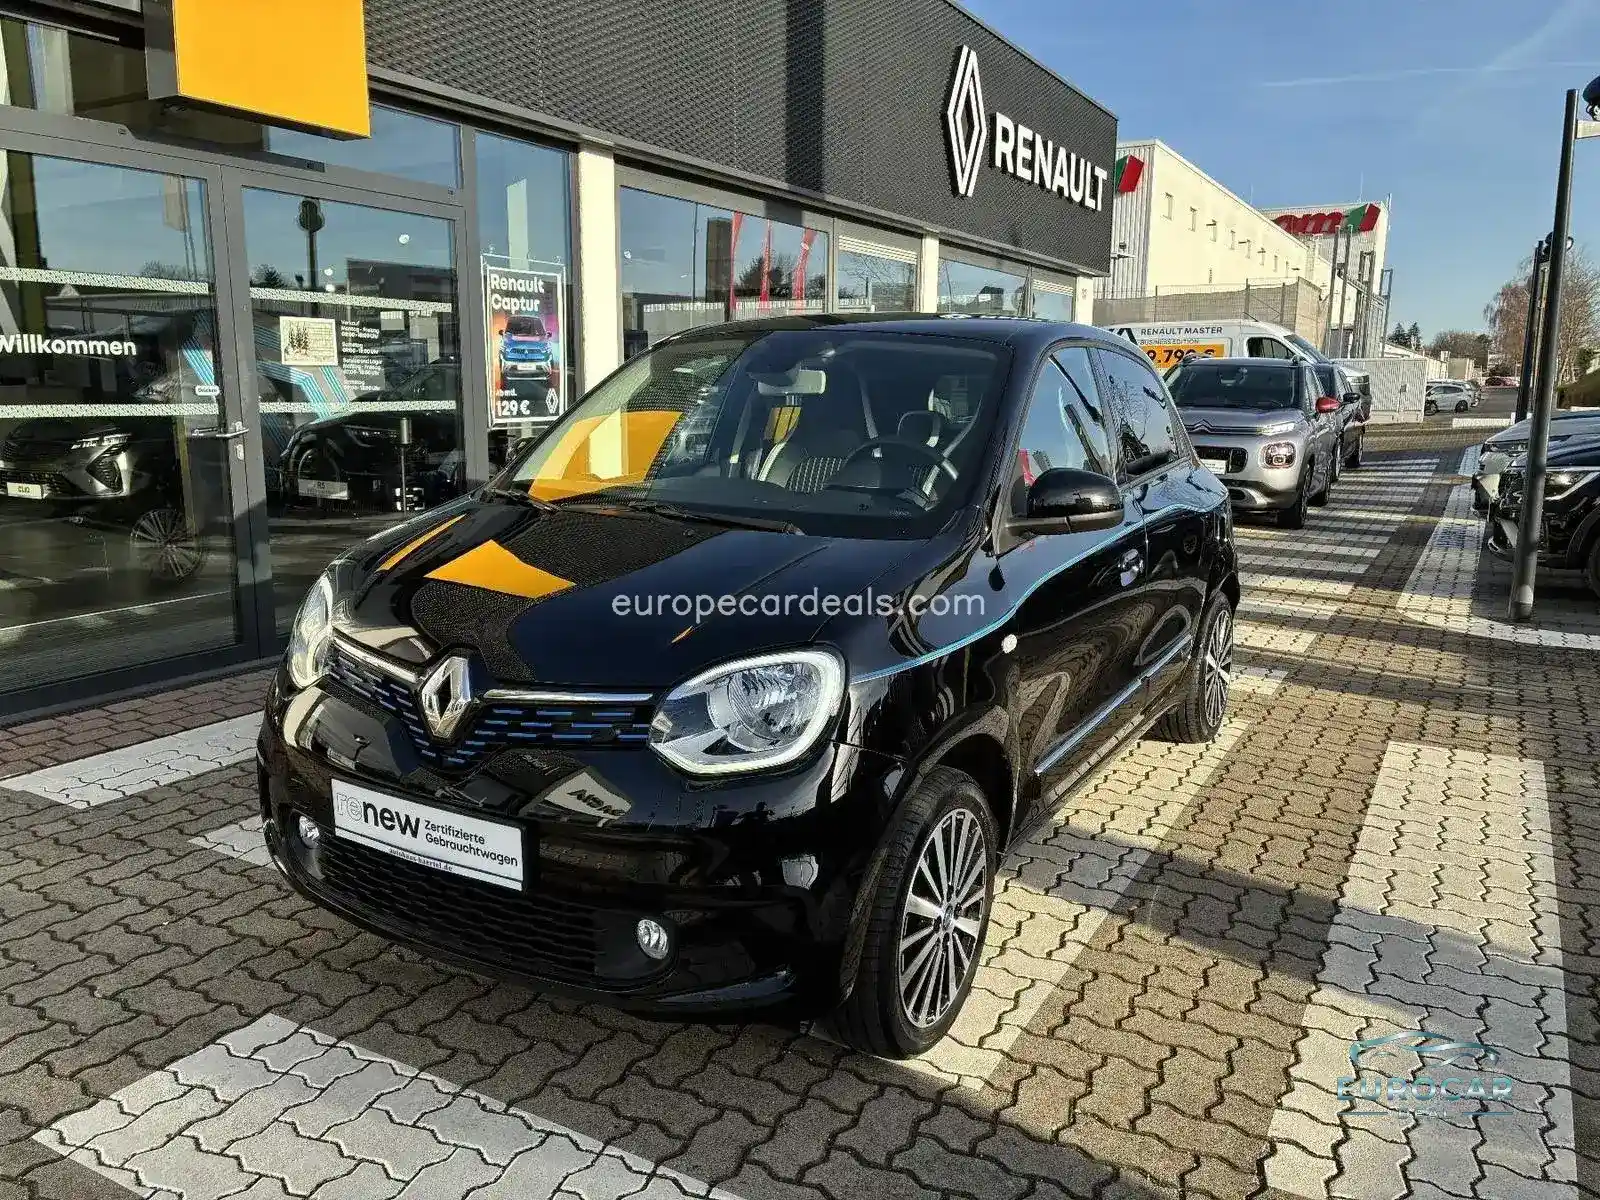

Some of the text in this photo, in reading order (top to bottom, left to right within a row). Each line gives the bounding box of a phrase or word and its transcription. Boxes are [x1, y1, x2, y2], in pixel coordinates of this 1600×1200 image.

[995, 112, 1107, 211] RENAULT
[490, 274, 544, 293] Renault
[491, 294, 540, 314] Captur
[0, 334, 136, 356] Willkommen
[496, 400, 530, 416] 129 €
[424, 819, 485, 845] Zertifizierte
[425, 832, 518, 867] Gebrauchtwagen
